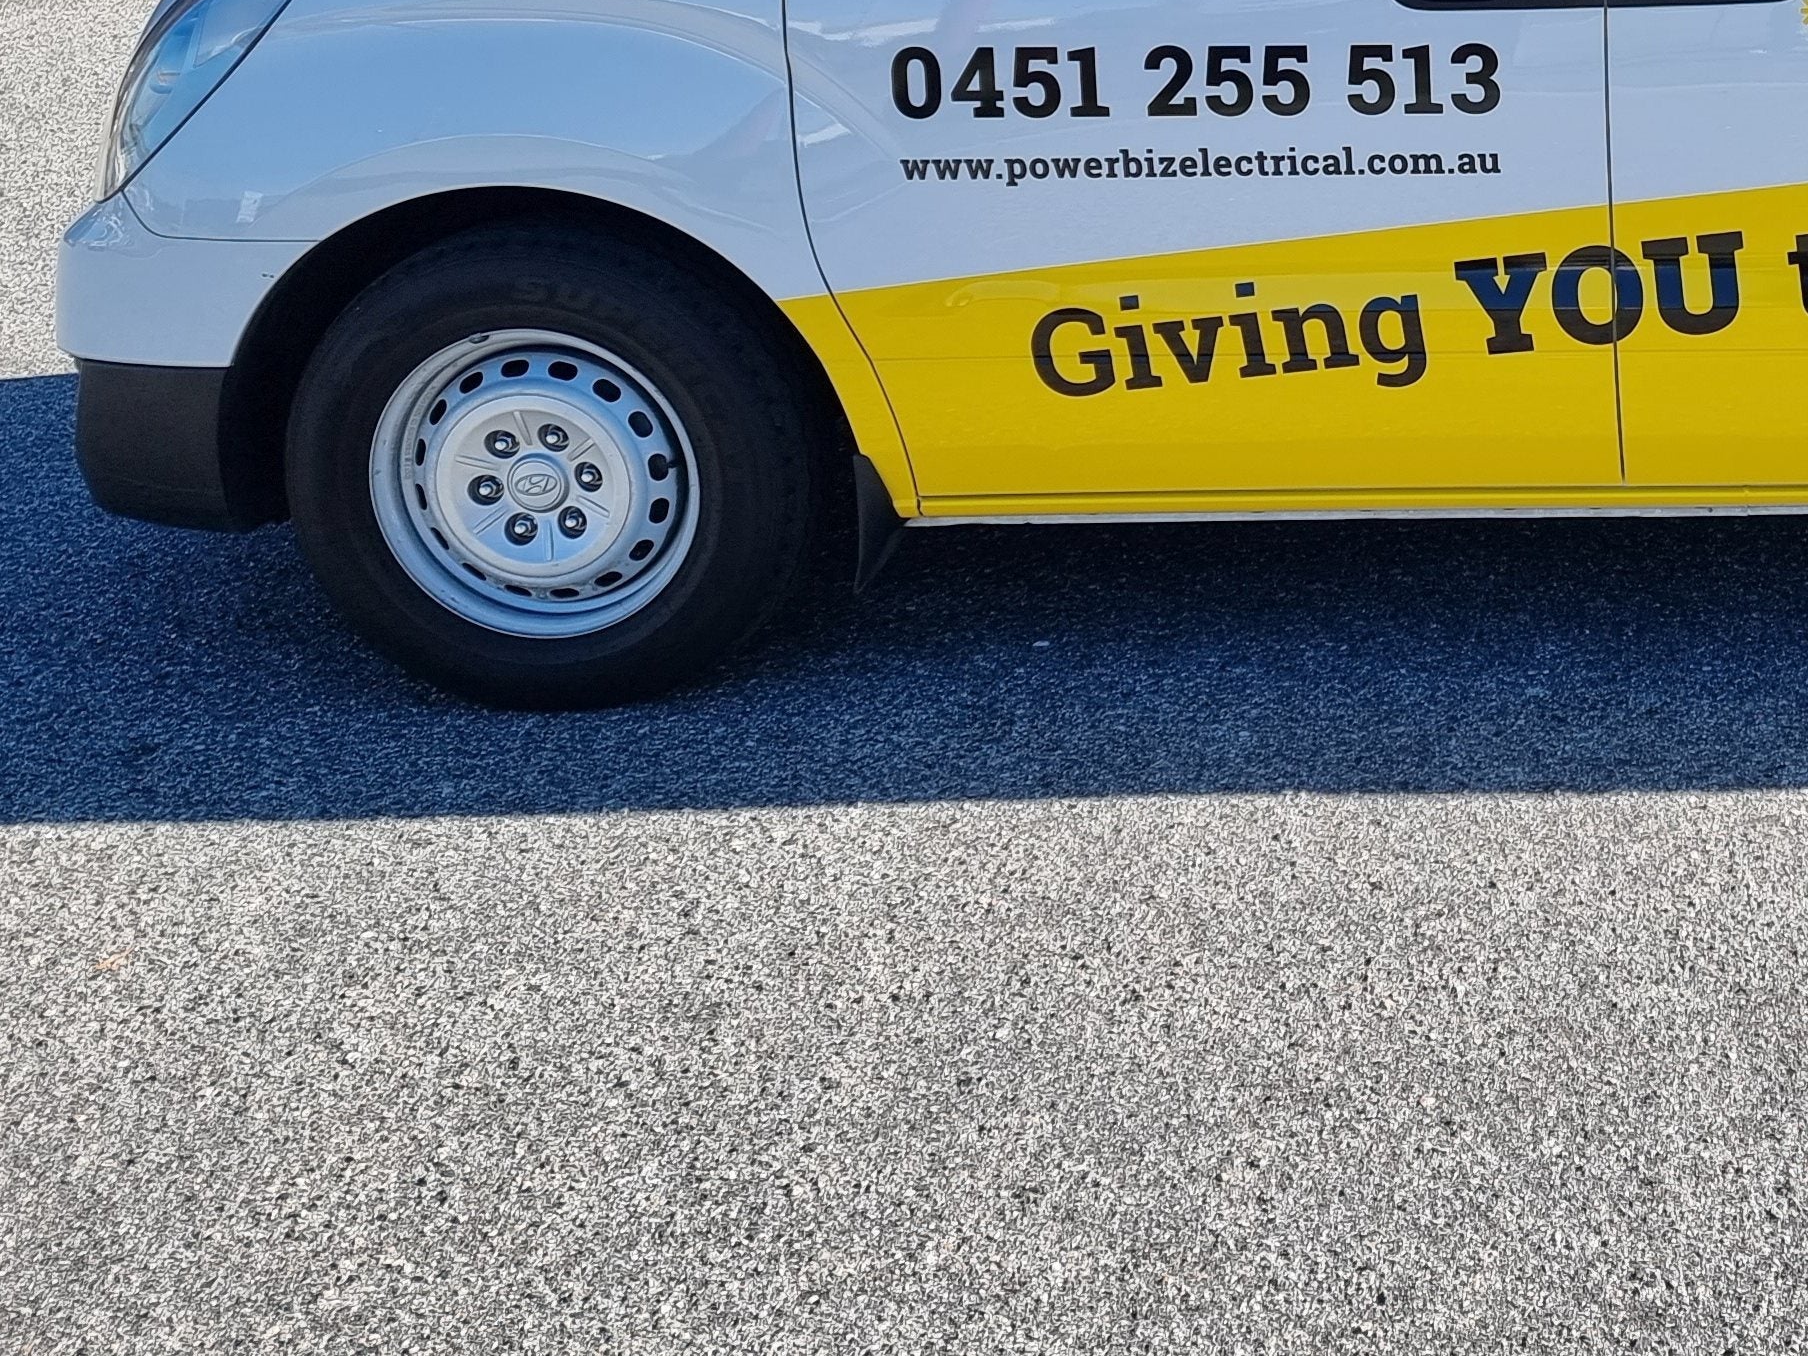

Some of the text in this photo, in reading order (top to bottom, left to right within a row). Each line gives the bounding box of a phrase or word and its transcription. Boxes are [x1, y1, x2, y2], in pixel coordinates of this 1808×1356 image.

[889, 41, 1502, 121] 0451 255 513
[899, 146, 1502, 187] www.powerbizelectrical.com.au
[1031, 278, 1430, 397] Giving
[1454, 230, 1745, 355] YOU
